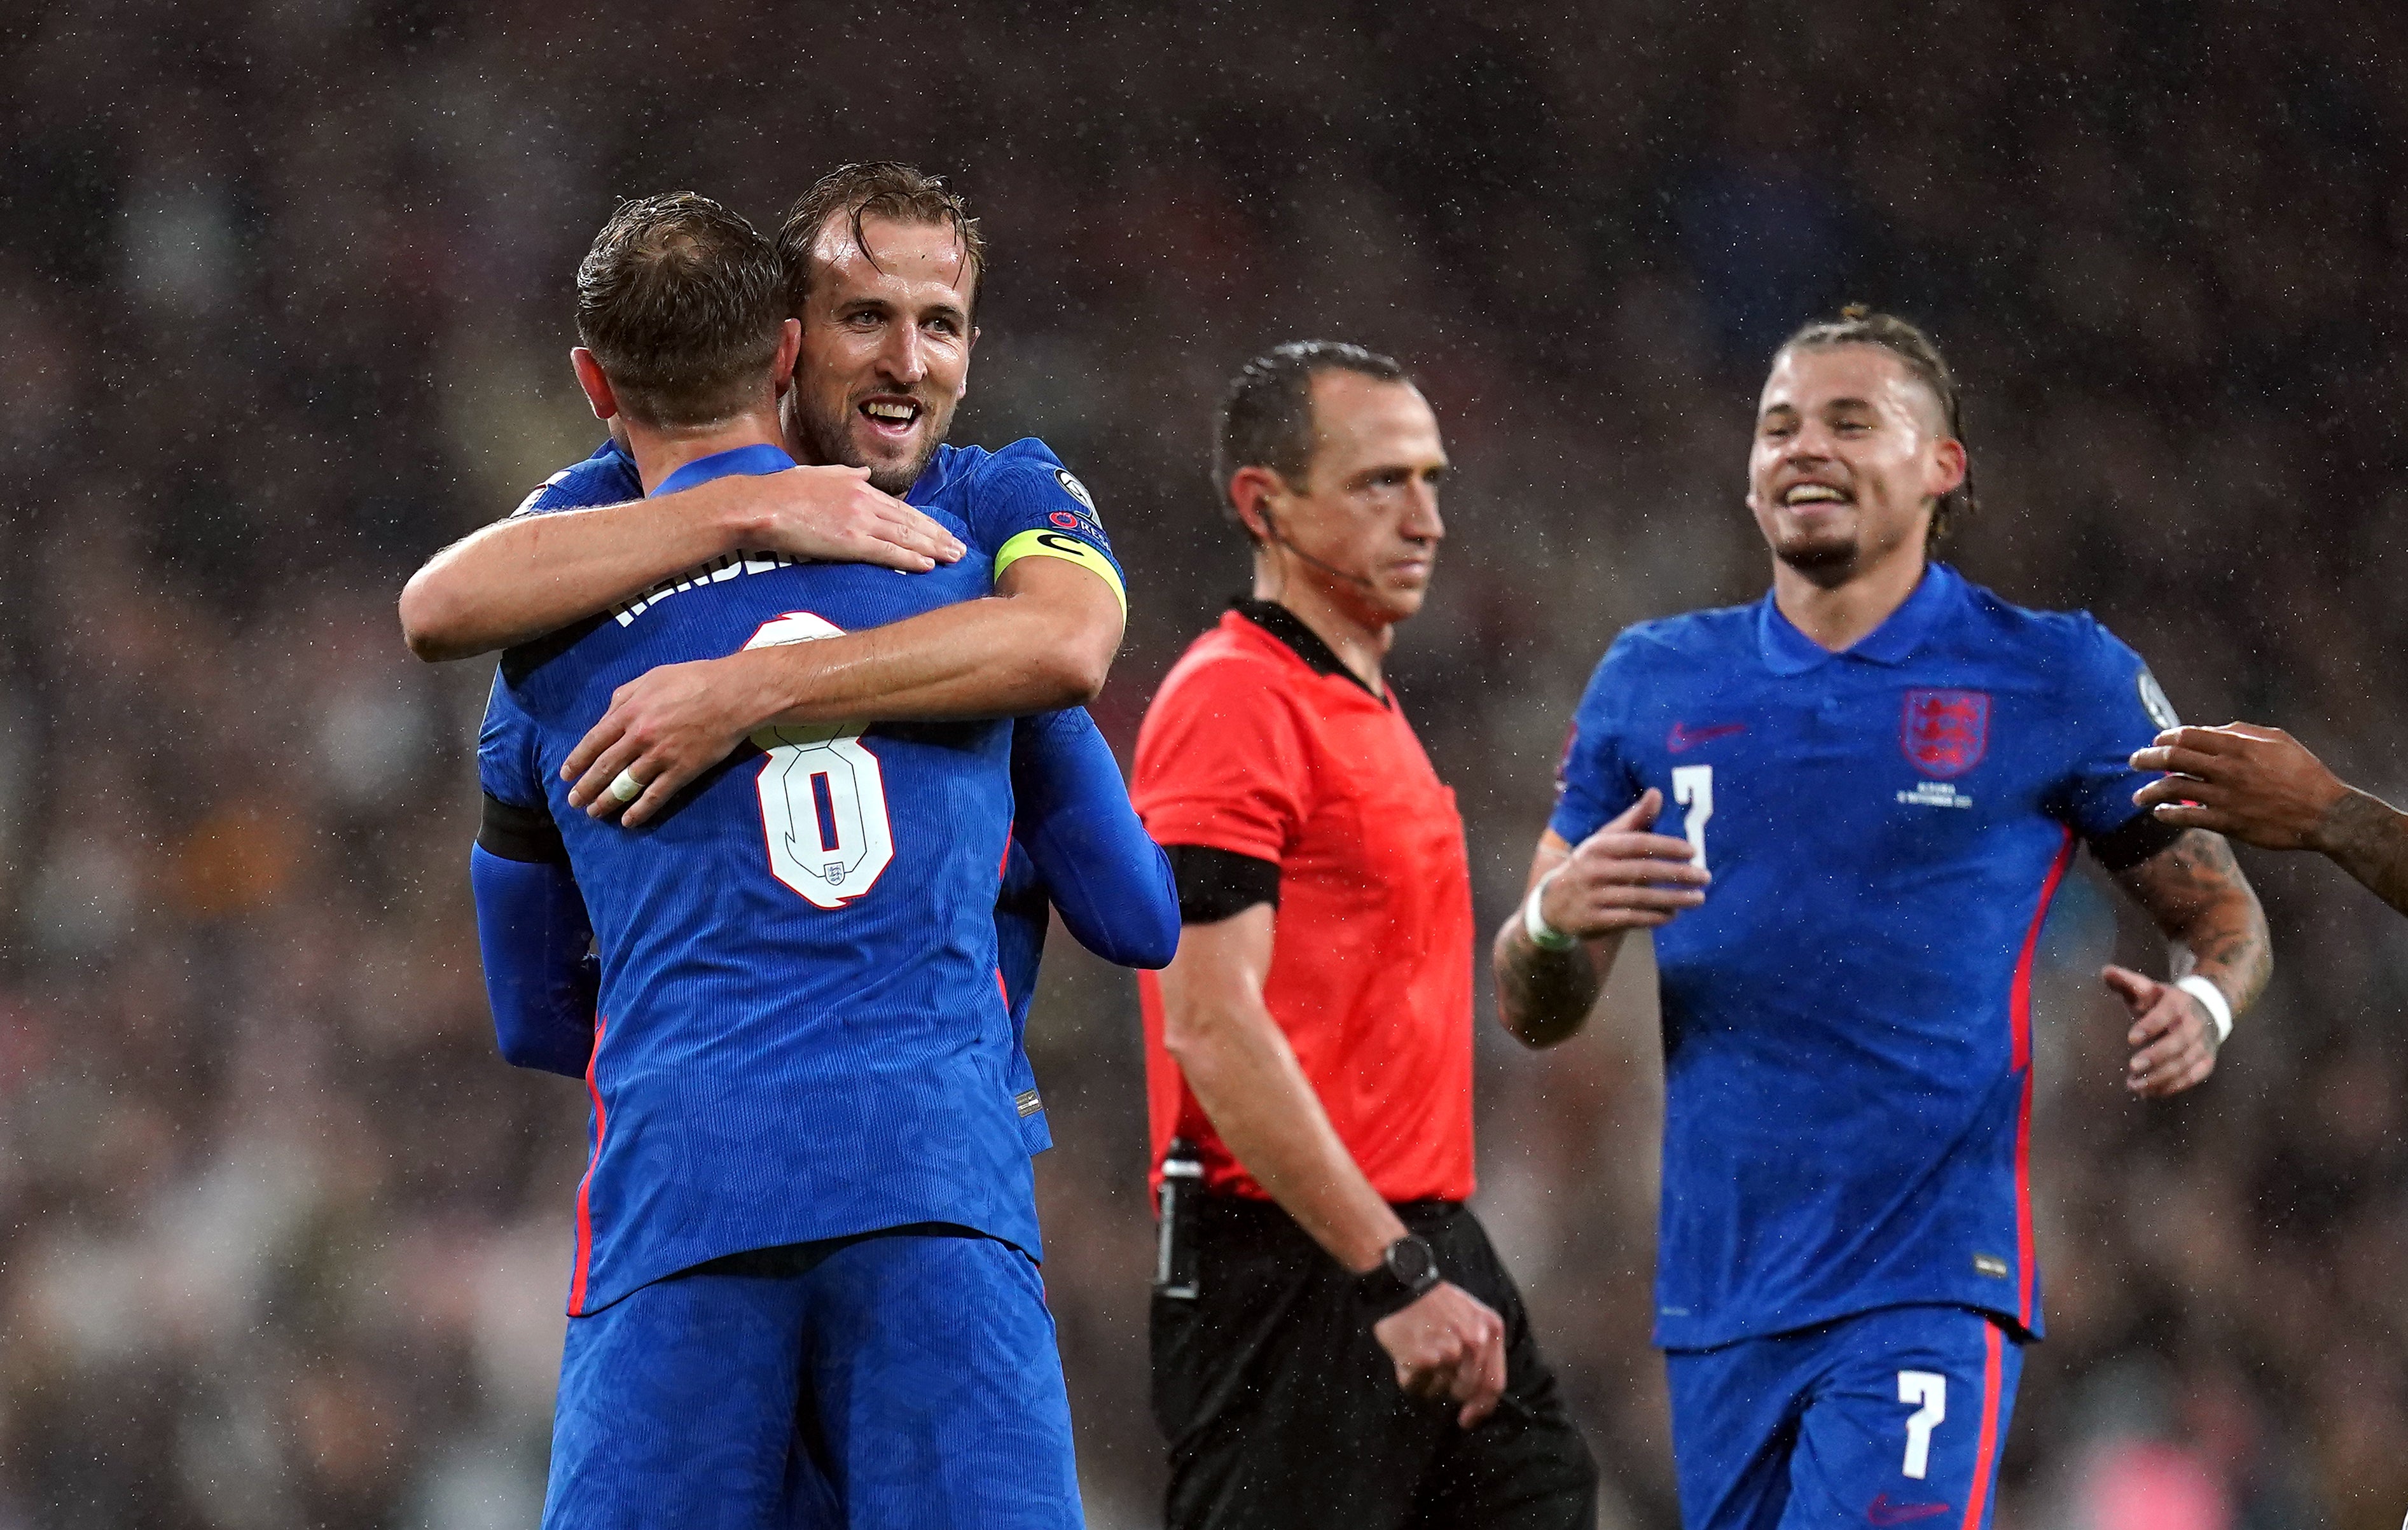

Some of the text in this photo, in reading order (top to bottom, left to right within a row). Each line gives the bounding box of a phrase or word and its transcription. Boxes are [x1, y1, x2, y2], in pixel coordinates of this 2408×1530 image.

[1037, 534, 1084, 557] C
[740, 611, 895, 910] 8
[1671, 765, 1713, 869] 7
[1897, 1370, 1946, 1480] 7
